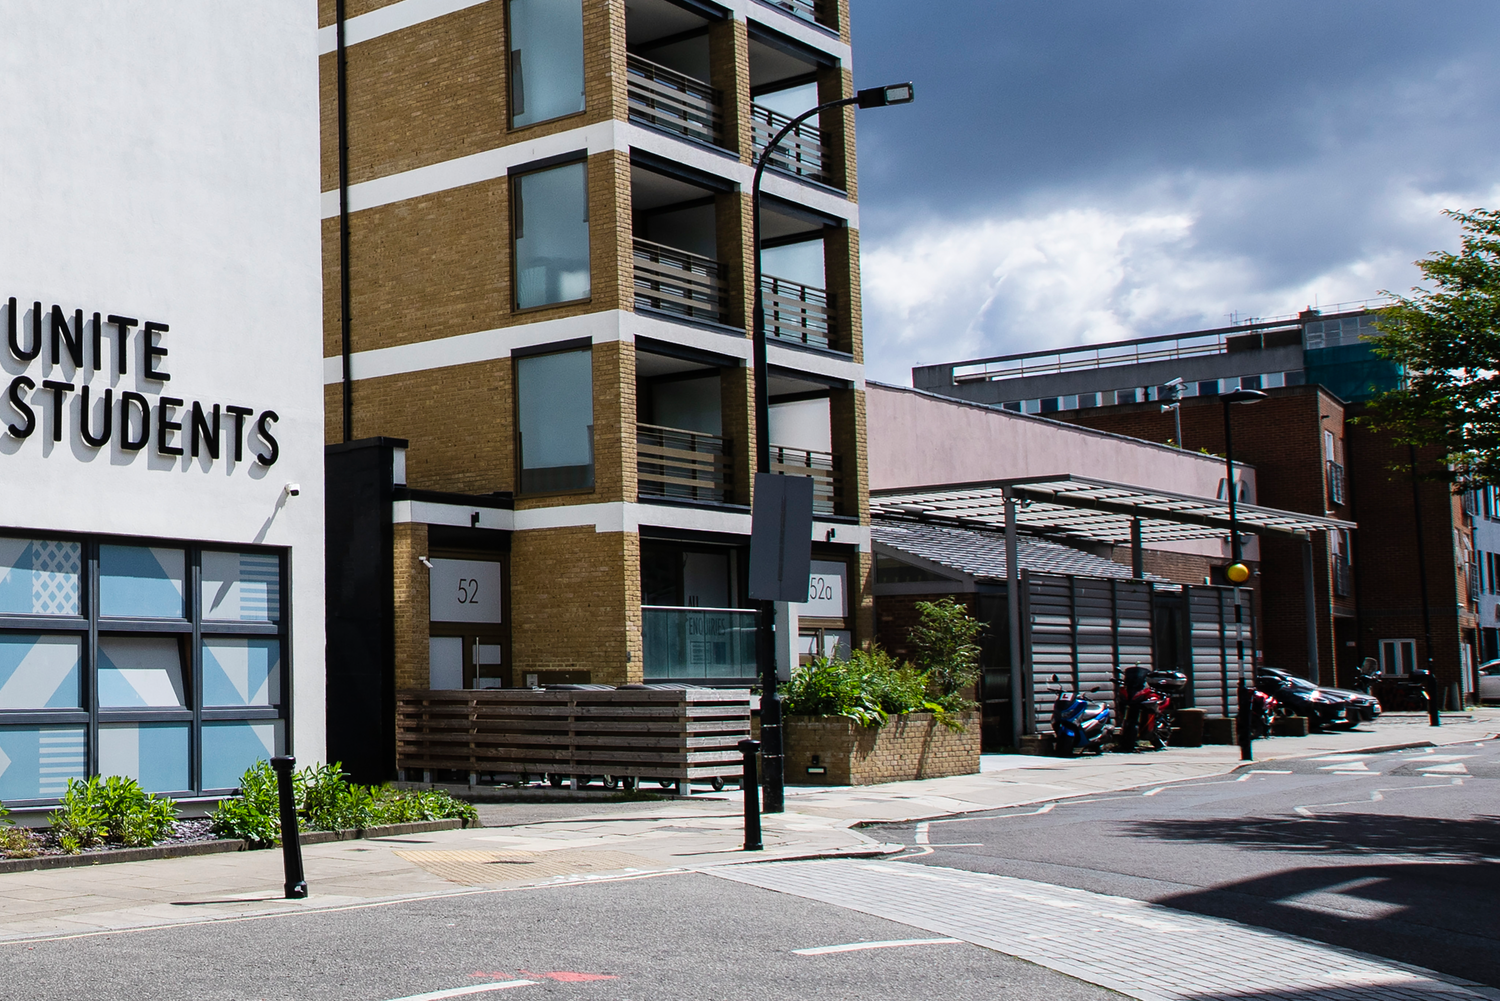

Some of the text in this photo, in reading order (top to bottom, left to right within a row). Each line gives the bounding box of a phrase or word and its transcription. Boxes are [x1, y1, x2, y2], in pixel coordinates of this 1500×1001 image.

[8, 296, 171, 381] UNITE
[8, 375, 279, 467] STUDENTS
[457, 578, 479, 604] 52
[810, 577, 833, 600] 52a
[689, 617, 726, 636] ENQUIRIES
